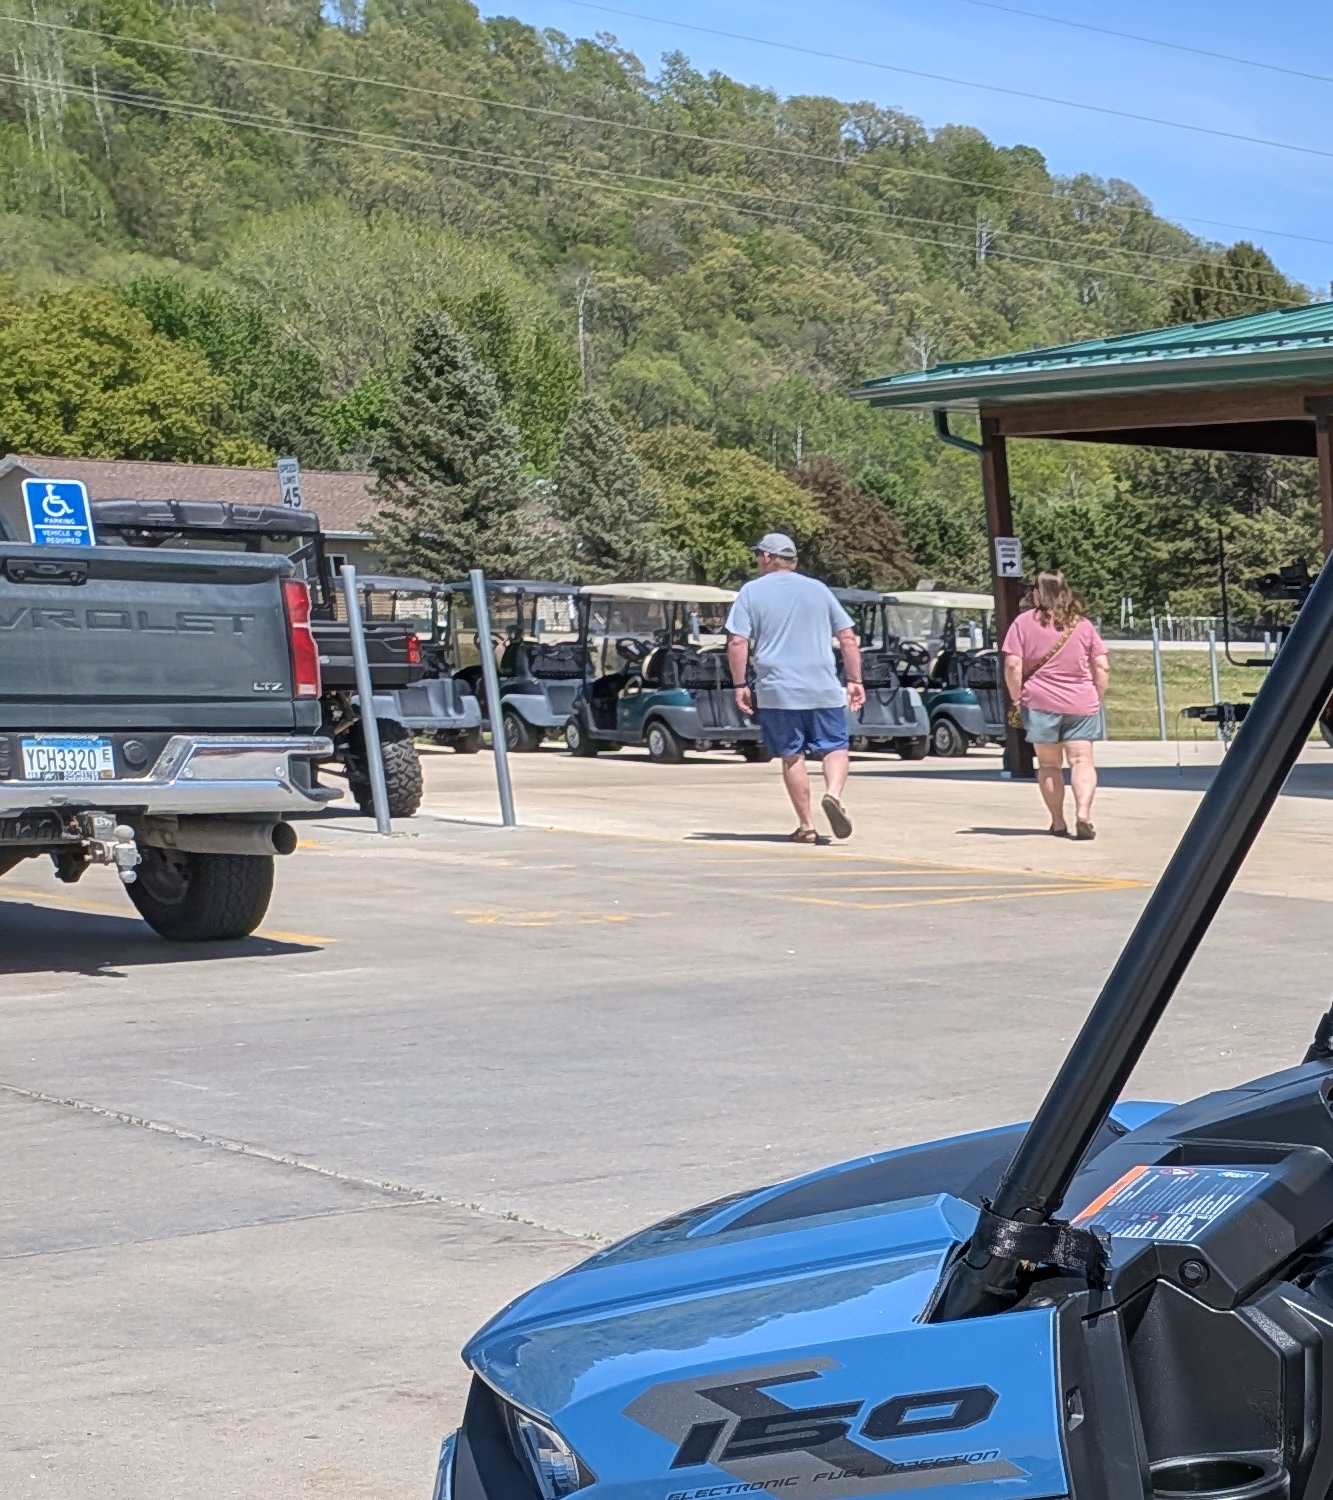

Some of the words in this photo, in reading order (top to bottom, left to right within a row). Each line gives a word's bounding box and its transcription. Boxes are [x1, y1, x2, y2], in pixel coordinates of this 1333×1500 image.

[284, 487, 301, 508] 45
[43, 517, 75, 525] PARKING
[253, 681, 284, 691] LTZ
[26, 749, 97, 770] YCH3320
[670, 1386, 999, 1469] 150
[812, 1468, 868, 1483] FUEL
[884, 1449, 999, 1474] INJECTION
